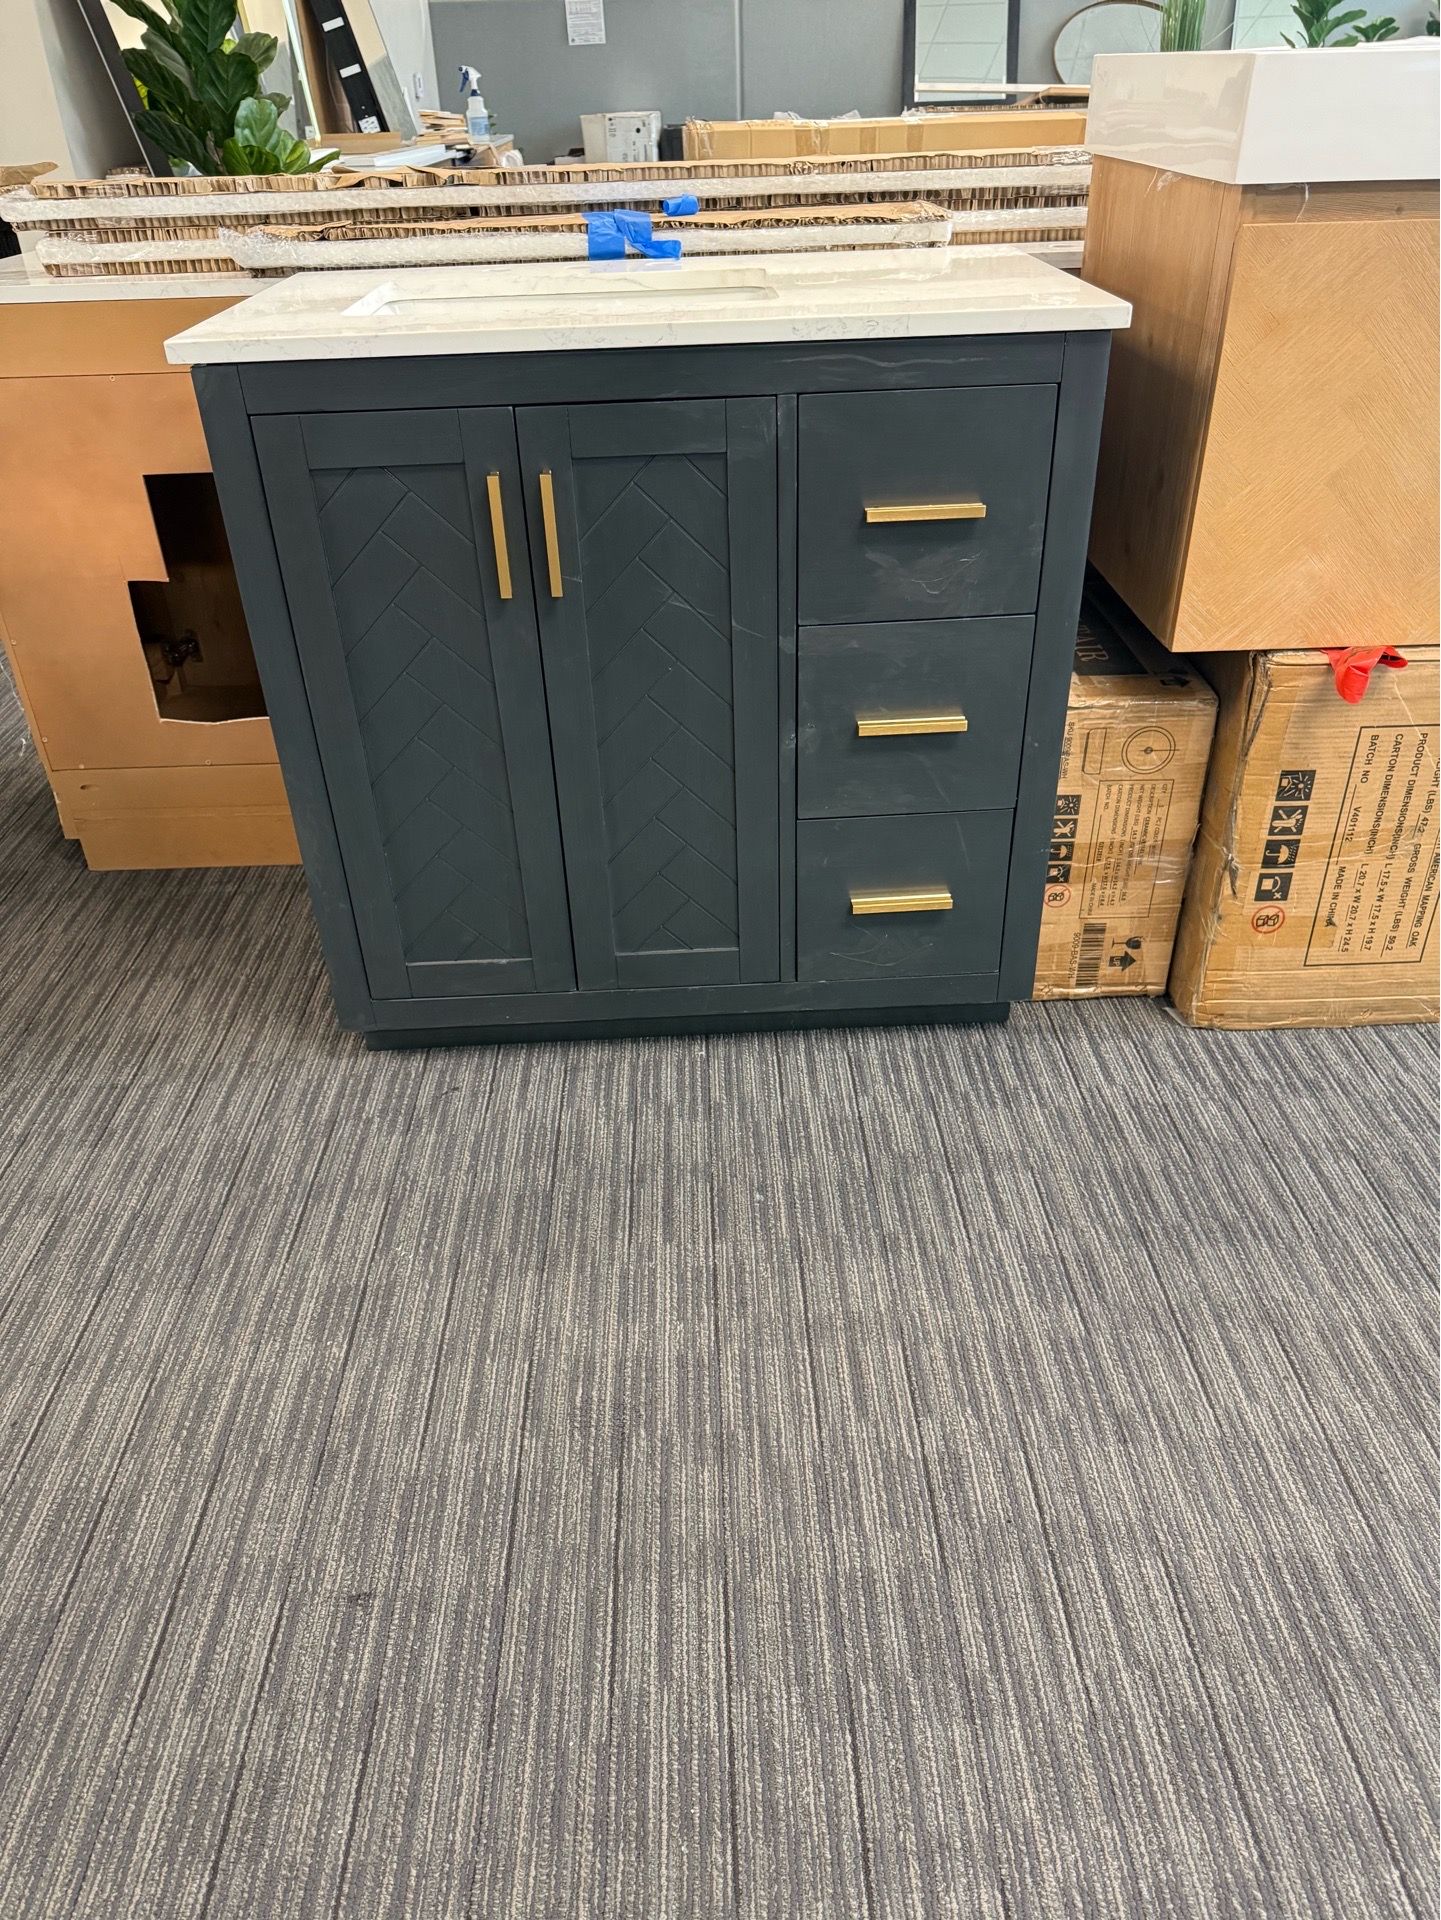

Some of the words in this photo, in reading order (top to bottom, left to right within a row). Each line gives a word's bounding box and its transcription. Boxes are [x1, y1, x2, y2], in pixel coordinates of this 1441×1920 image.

[1364, 735, 1378, 764] BATCH
[1387, 734, 1403, 771] CARTON
[1410, 733, 1427, 776] PRODUCT
[1359, 770, 1370, 783] NO
[1115, 784, 1124, 803] CARTON
[1125, 783, 1134, 806] PRODUCT
[1146, 783, 1156, 814] DESCRIPTION
[1423, 790, 1436, 813] (LBS)
[1110, 804, 1120, 834] DIMENSIONS
[1120, 807, 1130, 837] DIMENSIONS
[1345, 806, 1360, 841] V401112
[1407, 843, 1421, 872] GROSS
[1333, 866, 1346, 889] MADE
[1357, 870, 1366, 886] 20.7
[1380, 870, 1390, 885] 17.5
[1424, 852, 1440, 890] AMERICAN
[1330, 892, 1340, 900] IN
[1397, 877, 1412, 908] WEIGHT
[1348, 905, 1358, 920] 20.7
[1371, 905, 1381, 919] 17.5
[1390, 911, 1402, 932] (LBS)
[1414, 895, 1430, 927] MAPPING
[1341, 937, 1350, 952] 24.5
[1364, 936, 1373, 950] 19.7
[1385, 936, 1395, 950] 59.2
[1409, 931, 1419, 946] OAK
[1068, 932, 1080, 979] 9009-BAS-WH
[1112, 956, 1120, 967] UP
